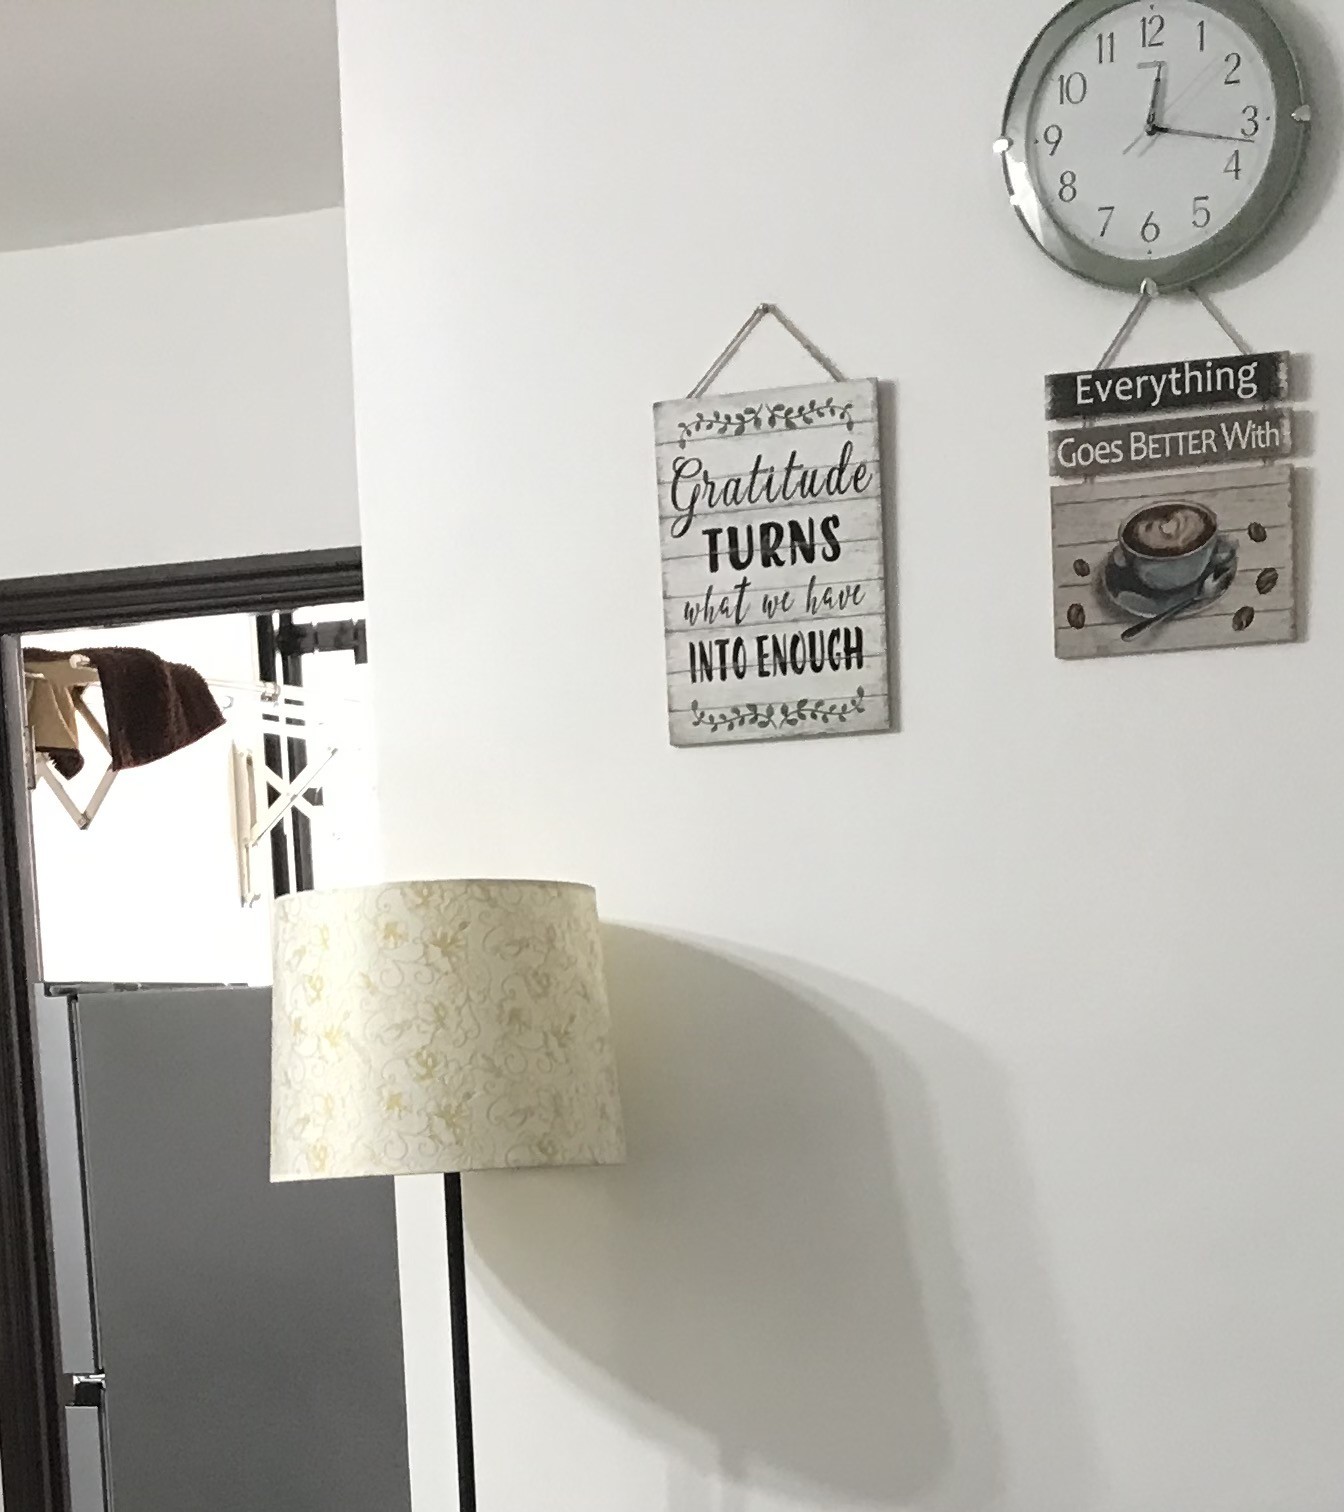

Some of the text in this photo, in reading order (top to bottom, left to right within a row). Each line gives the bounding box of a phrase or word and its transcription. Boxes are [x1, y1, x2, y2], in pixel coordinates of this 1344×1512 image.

[1140, 14, 1165, 48] 12
[1197, 20, 1206, 52] 1
[1096, 32, 1115, 64] 11
[1223, 52, 1242, 85] 2
[1058, 72, 1087, 105] 10
[1240, 105, 1259, 138] 3
[1043, 124, 1063, 156] 9
[1223, 149, 1241, 181] 4
[1058, 170, 1077, 202] 8
[1097, 206, 1115, 237] 7
[1140, 211, 1160, 243] 6
[1192, 195, 1211, 228] 5
[1075, 361, 1258, 407] Everything
[1057, 419, 1280, 468] Goes BETTER With
[670, 440, 873, 538] Gratitude
[701, 514, 841, 573] TURNS
[683, 575, 866, 626] what we have
[688, 626, 864, 684] INTO ENOUGH
